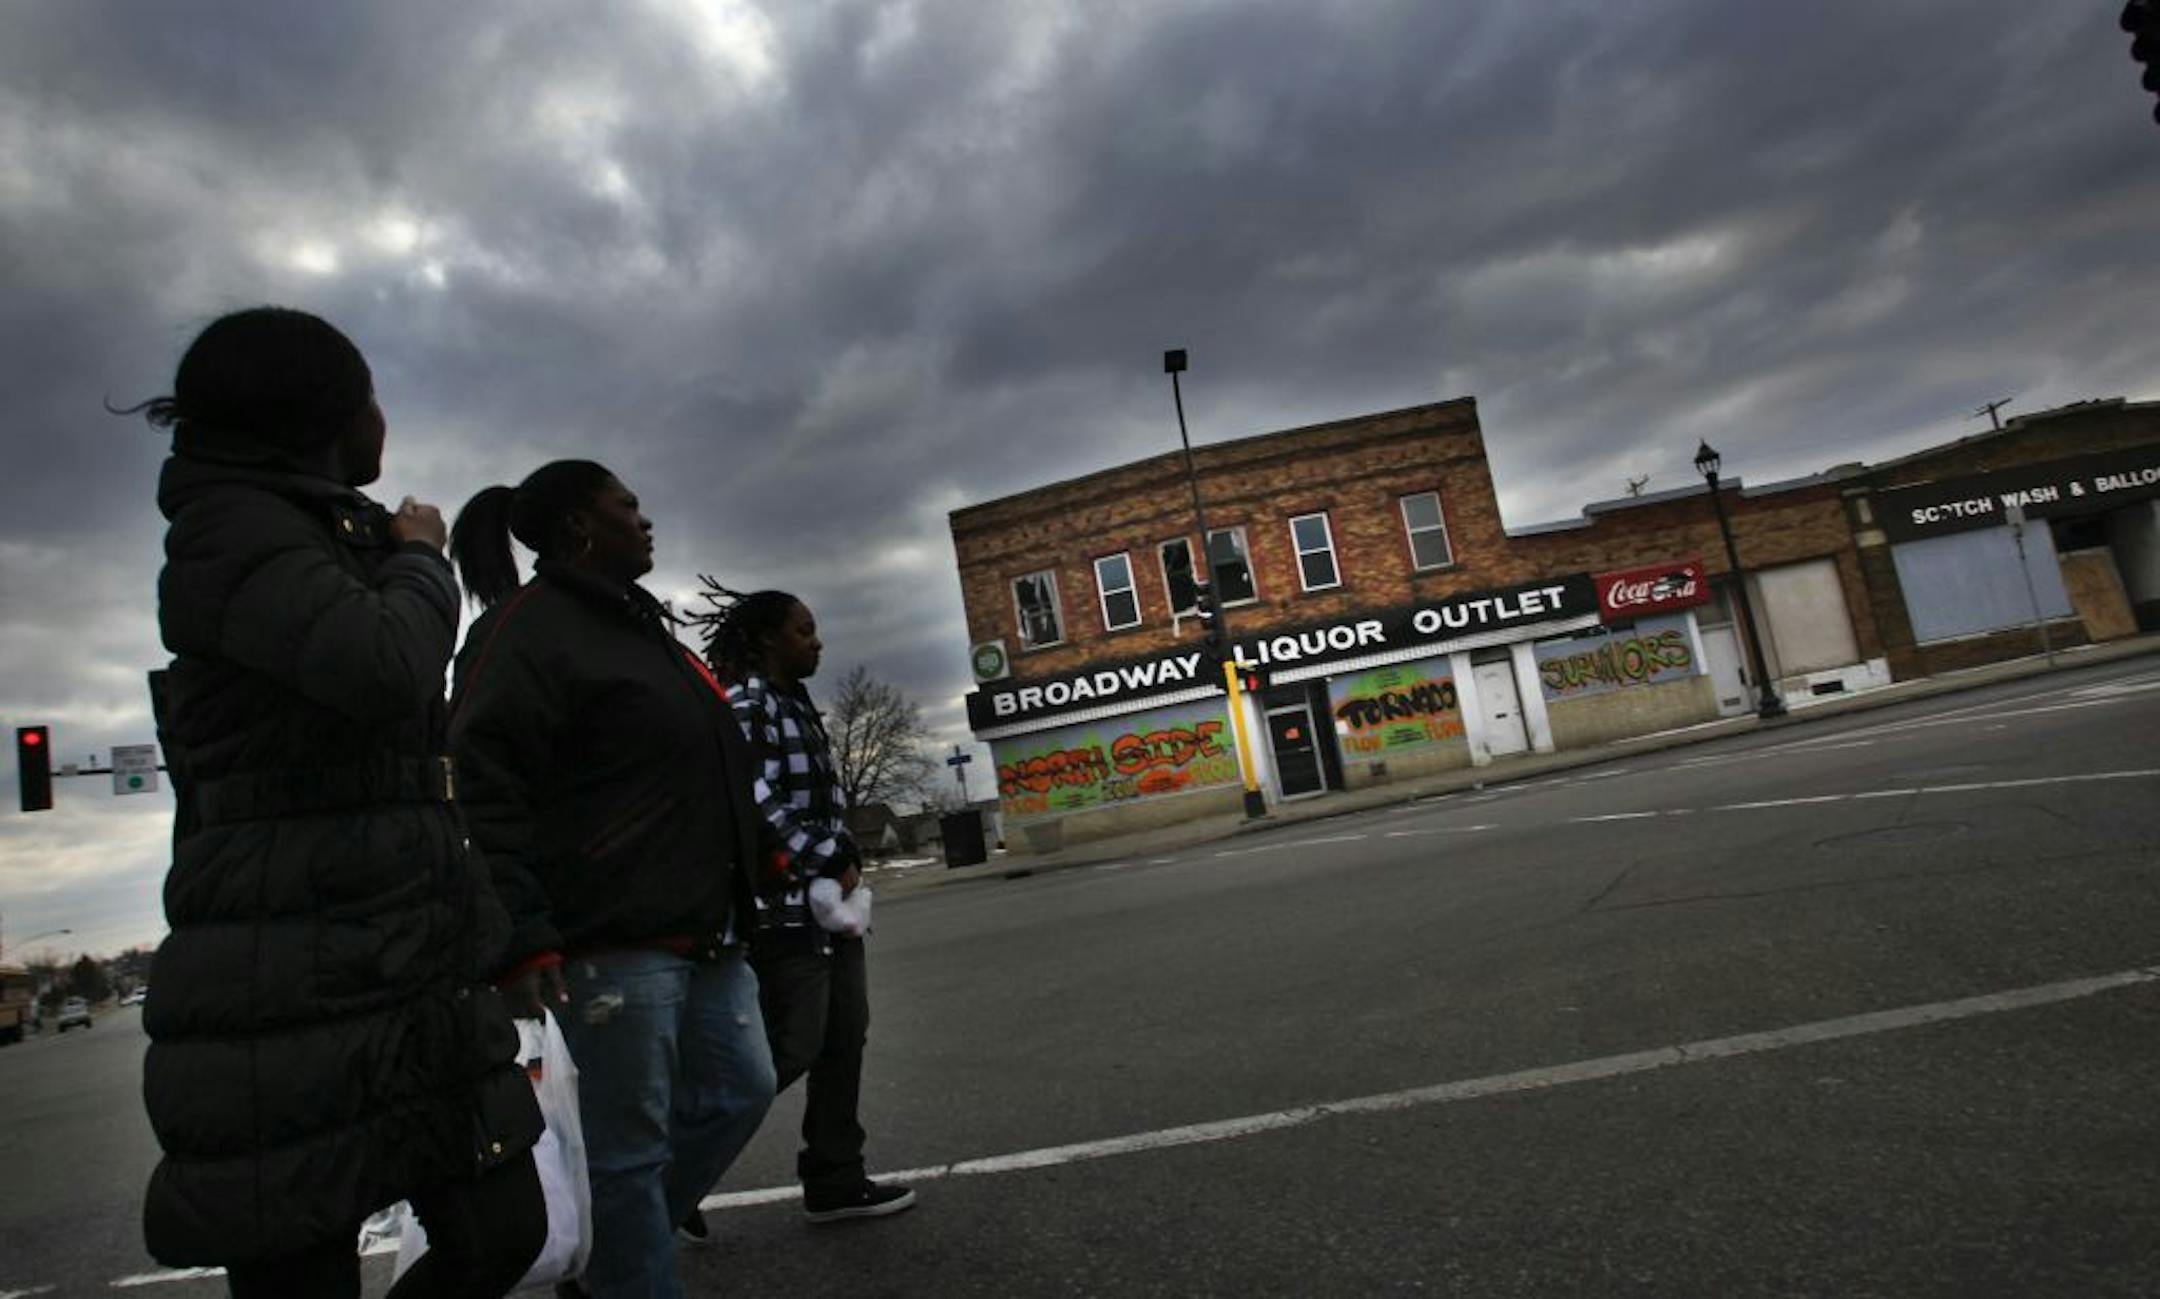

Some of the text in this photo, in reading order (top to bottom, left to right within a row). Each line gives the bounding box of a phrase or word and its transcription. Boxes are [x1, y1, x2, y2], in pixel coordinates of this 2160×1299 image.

[2001, 486, 2058, 508] WASH
[2070, 481, 2085, 496] &
[2095, 467, 2160, 492] BALLO
[993, 586, 1565, 716] BROADWAY LIQUOR OUTLET
[1111, 721, 1223, 774] SIDE
